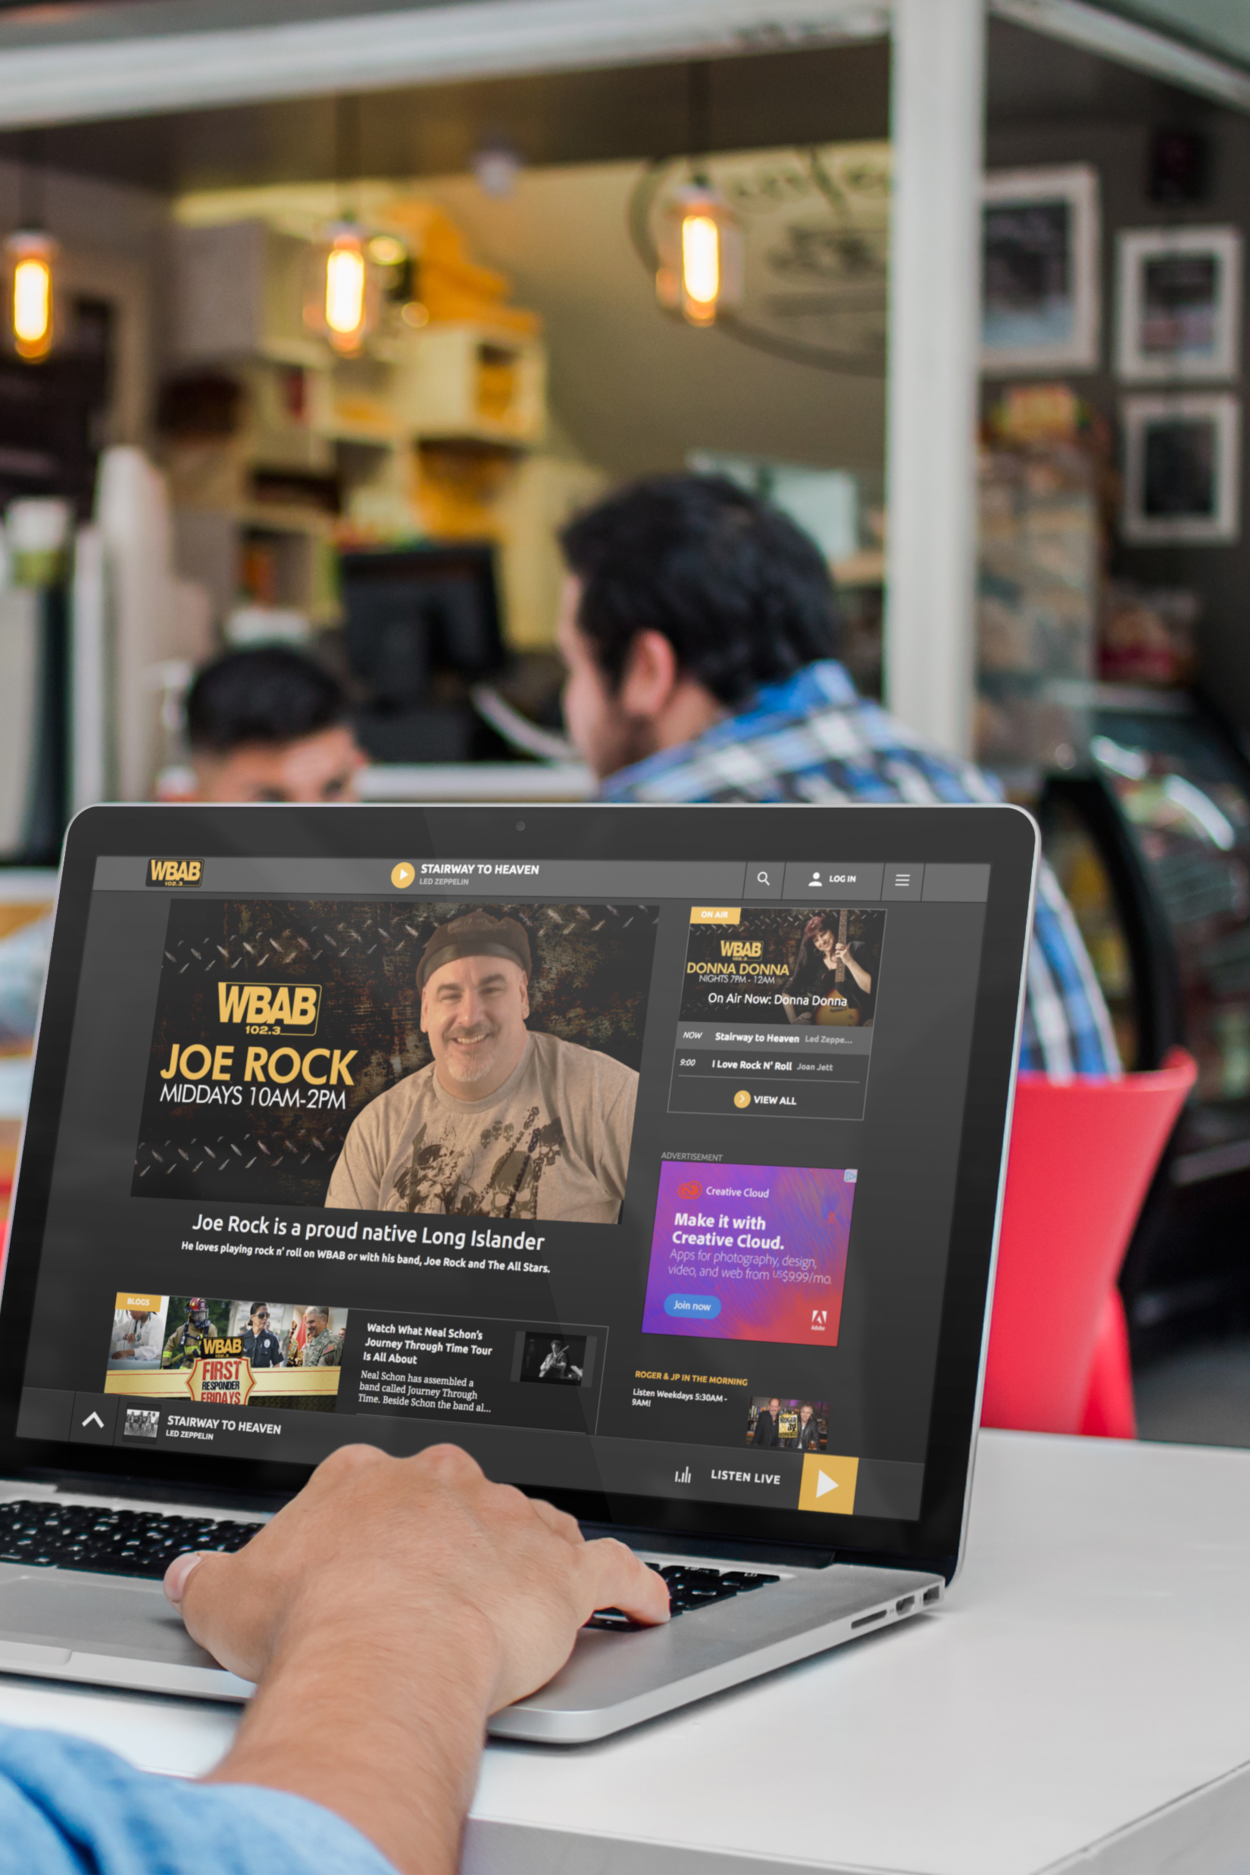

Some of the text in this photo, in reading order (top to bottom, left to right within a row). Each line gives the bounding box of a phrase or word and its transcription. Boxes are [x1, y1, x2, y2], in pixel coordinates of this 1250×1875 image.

[150, 860, 201, 882] WBAB
[420, 864, 539, 876] STAIRWAY TO HEAVEN
[435, 878, 469, 886] ZEPPELIN
[829, 875, 846, 883] LOG
[721, 940, 761, 957] WBAB
[687, 962, 789, 975] DONNA DONNA
[699, 974, 775, 984] NIGHTS 7PM 12AM
[218, 982, 317, 1025] WBAB
[708, 993, 848, 1006] On Air Now: Donna Donna
[245, 1025, 281, 1035] 102.3
[683, 1031, 702, 1039] NOW
[715, 1032, 800, 1045] Stairway to Heaven
[160, 1043, 359, 1085] JOE ROCK
[712, 1060, 715, 1068] I
[717, 1060, 738, 1068] Love
[740, 1060, 762, 1070] Rock
[774, 1062, 793, 1070] Roll
[796, 1062, 834, 1071] Joan Jett
[159, 1083, 346, 1110] MIDDAYS 10AM-2PM
[754, 1096, 797, 1105] VIEW ALL
[661, 1152, 723, 1162] ADVERTISEMENT
[706, 1187, 769, 1198] Creative Cloud
[674, 1213, 766, 1230] Make it with
[192, 1214, 545, 1250] Joe Rock is a proud native Long Islander
[672, 1231, 785, 1250] Creative Cloud.
[181, 1241, 194, 1250] He
[196, 1242, 219, 1252] loves
[220, 1243, 252, 1255] playing
[255, 1245, 274, 1255] rock
[286, 1248, 301, 1257] roll
[303, 1250, 315, 1258] on
[317, 1250, 345, 1260] WBAB
[347, 1252, 358, 1260] or
[360, 1252, 380, 1262] with
[382, 1254, 395, 1263] his
[397, 1254, 422, 1267] band,
[424, 1257, 441, 1266] Joe
[443, 1258, 466, 1267] Rock
[468, 1259, 486, 1268] and
[488, 1260, 505, 1270] The
[507, 1261, 521, 1271] All
[523, 1263, 551, 1273] Stars.
[669, 1249, 817, 1270] Apps for photography, design,
[668, 1265, 697, 1278] video,
[699, 1266, 718, 1277] and
[722, 1267, 743, 1278] web
[746, 1268, 769, 1279] from
[127, 1298, 150, 1306] BLOGS
[673, 1300, 711, 1311] Join now
[367, 1323, 396, 1334] Watch
[398, 1325, 423, 1336] What
[424, 1327, 446, 1338] Neal
[203, 1338, 242, 1354] WBAB
[365, 1337, 492, 1356] Journey Through Time Tour
[363, 1352, 417, 1365] Is All About
[203, 1361, 241, 1380] FIRST
[635, 1371, 748, 1386] ROGER & JP IN THE MORNING
[202, 1381, 240, 1390] RESPONDER
[201, 1391, 240, 1405] FRIDAYS
[633, 1389, 723, 1402] Listen Weekdays 5:30AM
[632, 1398, 651, 1407] 9AM!
[168, 1415, 281, 1434] STAIRWAY TO HEAVEN
[711, 1470, 780, 1485] LISTEN LIVE
